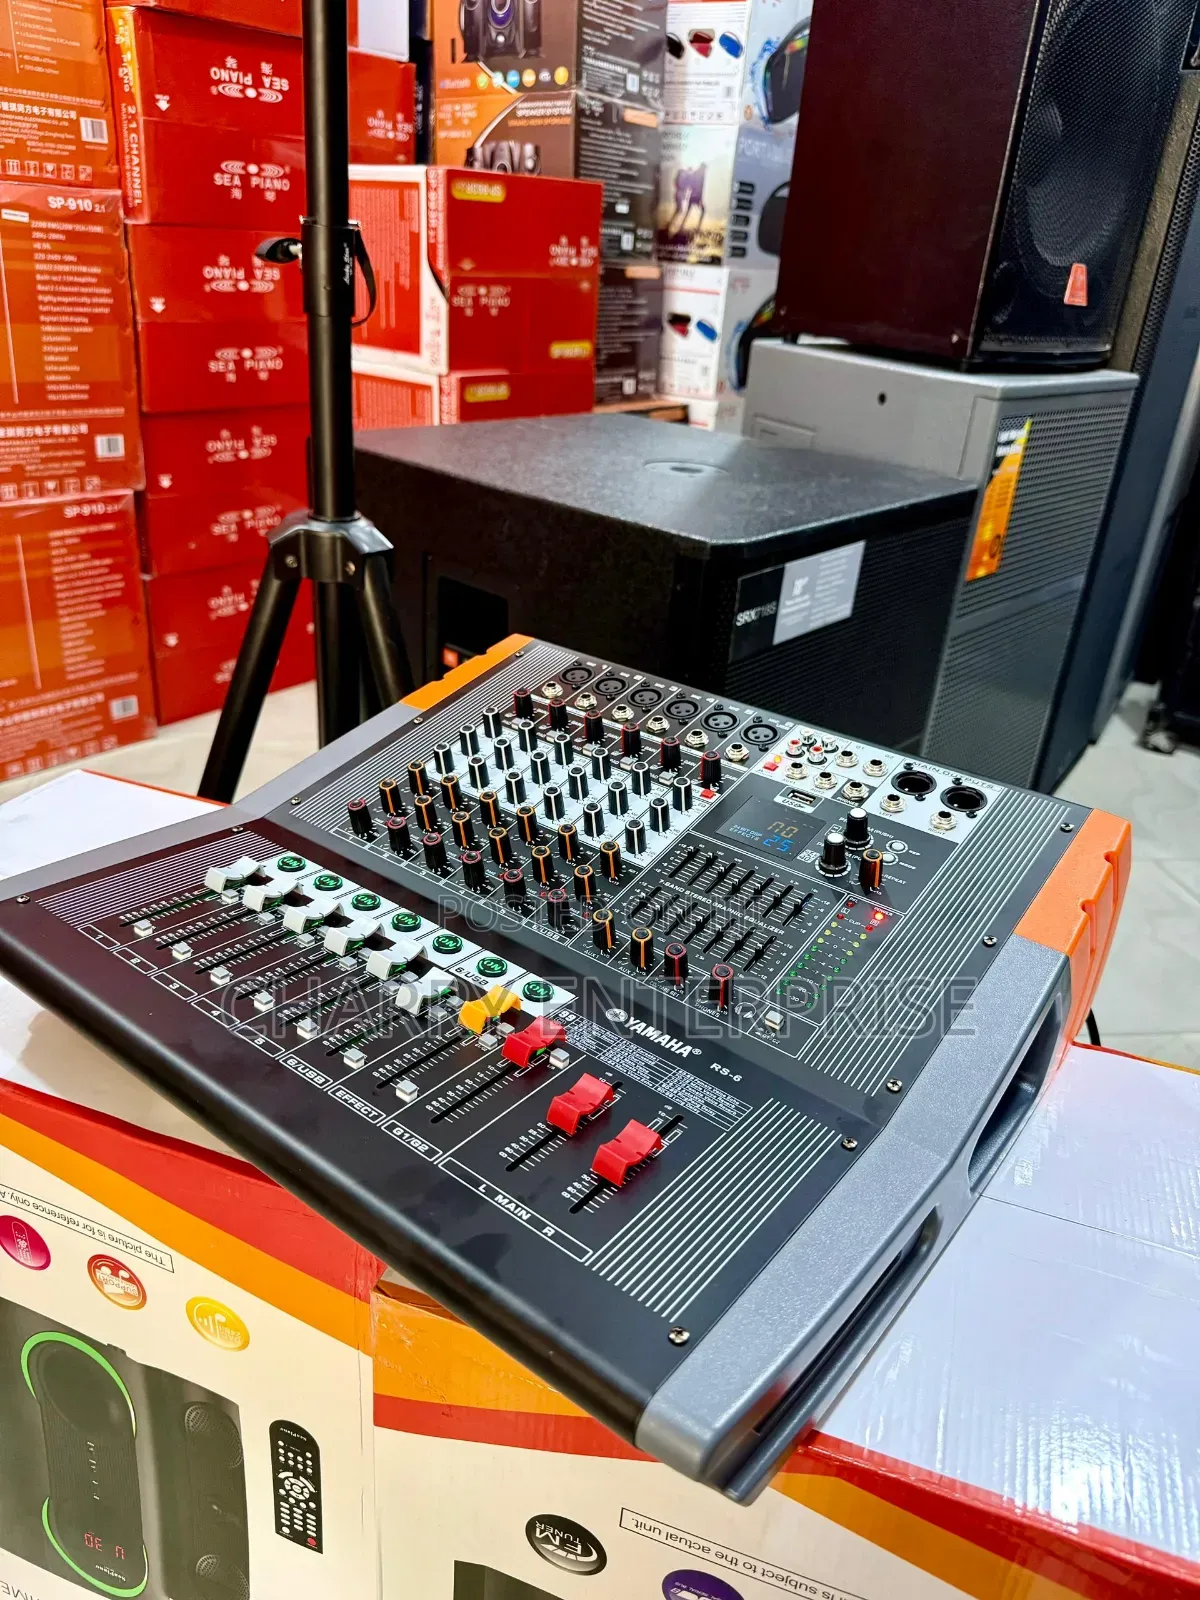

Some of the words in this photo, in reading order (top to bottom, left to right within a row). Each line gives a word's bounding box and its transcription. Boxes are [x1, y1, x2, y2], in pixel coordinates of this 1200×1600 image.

[210, 67, 253, 86] PIANO
[262, 75, 289, 91] SEA
[129, 133, 142, 206] CHANNEL
[213, 173, 242, 187] SEA
[250, 176, 290, 191] PIANO
[47, 196, 92, 212] SP-910
[202, 266, 245, 280] PIANO
[253, 268, 280, 281] SEA
[208, 360, 236, 373] SEA
[244, 357, 283, 371] PIANO
[912, 761, 940, 774] MAIN
[941, 771, 994, 789] OUTPUTS
[883, 874, 907, 885] REPEAT
[684, 890, 711, 905] STEREO
[712, 902, 743, 918] GRAPHIC
[744, 914, 785, 935] EQUALIZER
[532, 924, 560, 940] 6/USB
[455, 966, 489, 986] 6/USB
[558, 1010, 577, 1022] 99
[624, 1017, 693, 1058] YAMAHA
[287, 1058, 326, 1085] 6/USB
[710, 1063, 743, 1082] RS-6
[335, 1090, 379, 1119] EFFECT
[392, 1127, 429, 1153] G1/G2
[7, 1191, 32, 1209] only.
[42, 1206, 80, 1229] reference
[478, 1184, 487, 1194] L
[494, 1194, 531, 1221] MAIN
[542, 1226, 556, 1238] R
[83, 1223, 96, 1235] for
[97, 1229, 107, 1240] is
[107, 1234, 142, 1256] picture
[144, 1249, 166, 1266] The
[96, 1274, 139, 1297] SUPPORT
[535, 1521, 581, 1545] TUNER
[631, 1517, 662, 1536] unit.
[536, 1527, 582, 1555] FM
[665, 1532, 711, 1555] actual
[715, 1551, 739, 1567] the
[742, 1559, 758, 1574] to
[761, 1567, 817, 1596] subject
